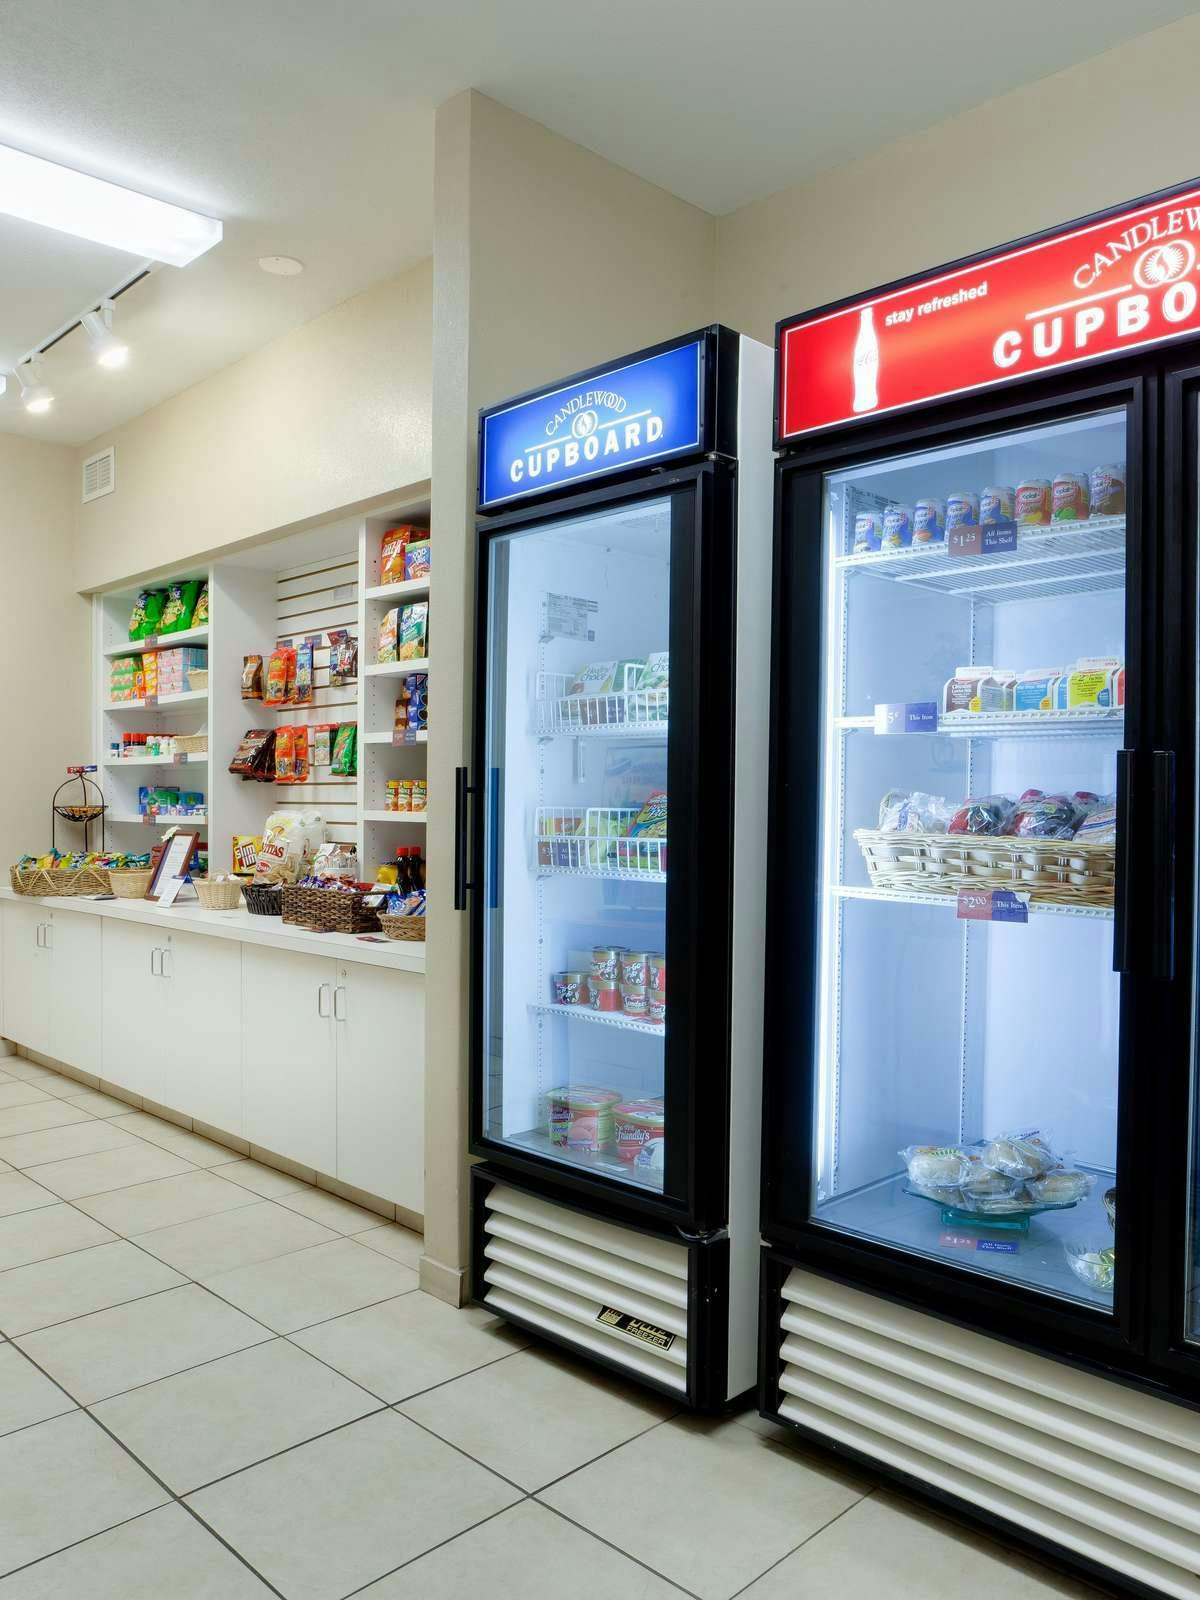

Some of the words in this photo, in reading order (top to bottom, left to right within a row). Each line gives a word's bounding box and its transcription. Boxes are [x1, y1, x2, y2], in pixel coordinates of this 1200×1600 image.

[885, 306, 914, 327] stay
[917, 281, 989, 317] refreshed
[545, 389, 628, 436] CANDLEWOOD
[510, 415, 664, 483] CUPBOARD
[997, 900, 1009, 909] This
[626, 1325, 666, 1346] FREEZER
